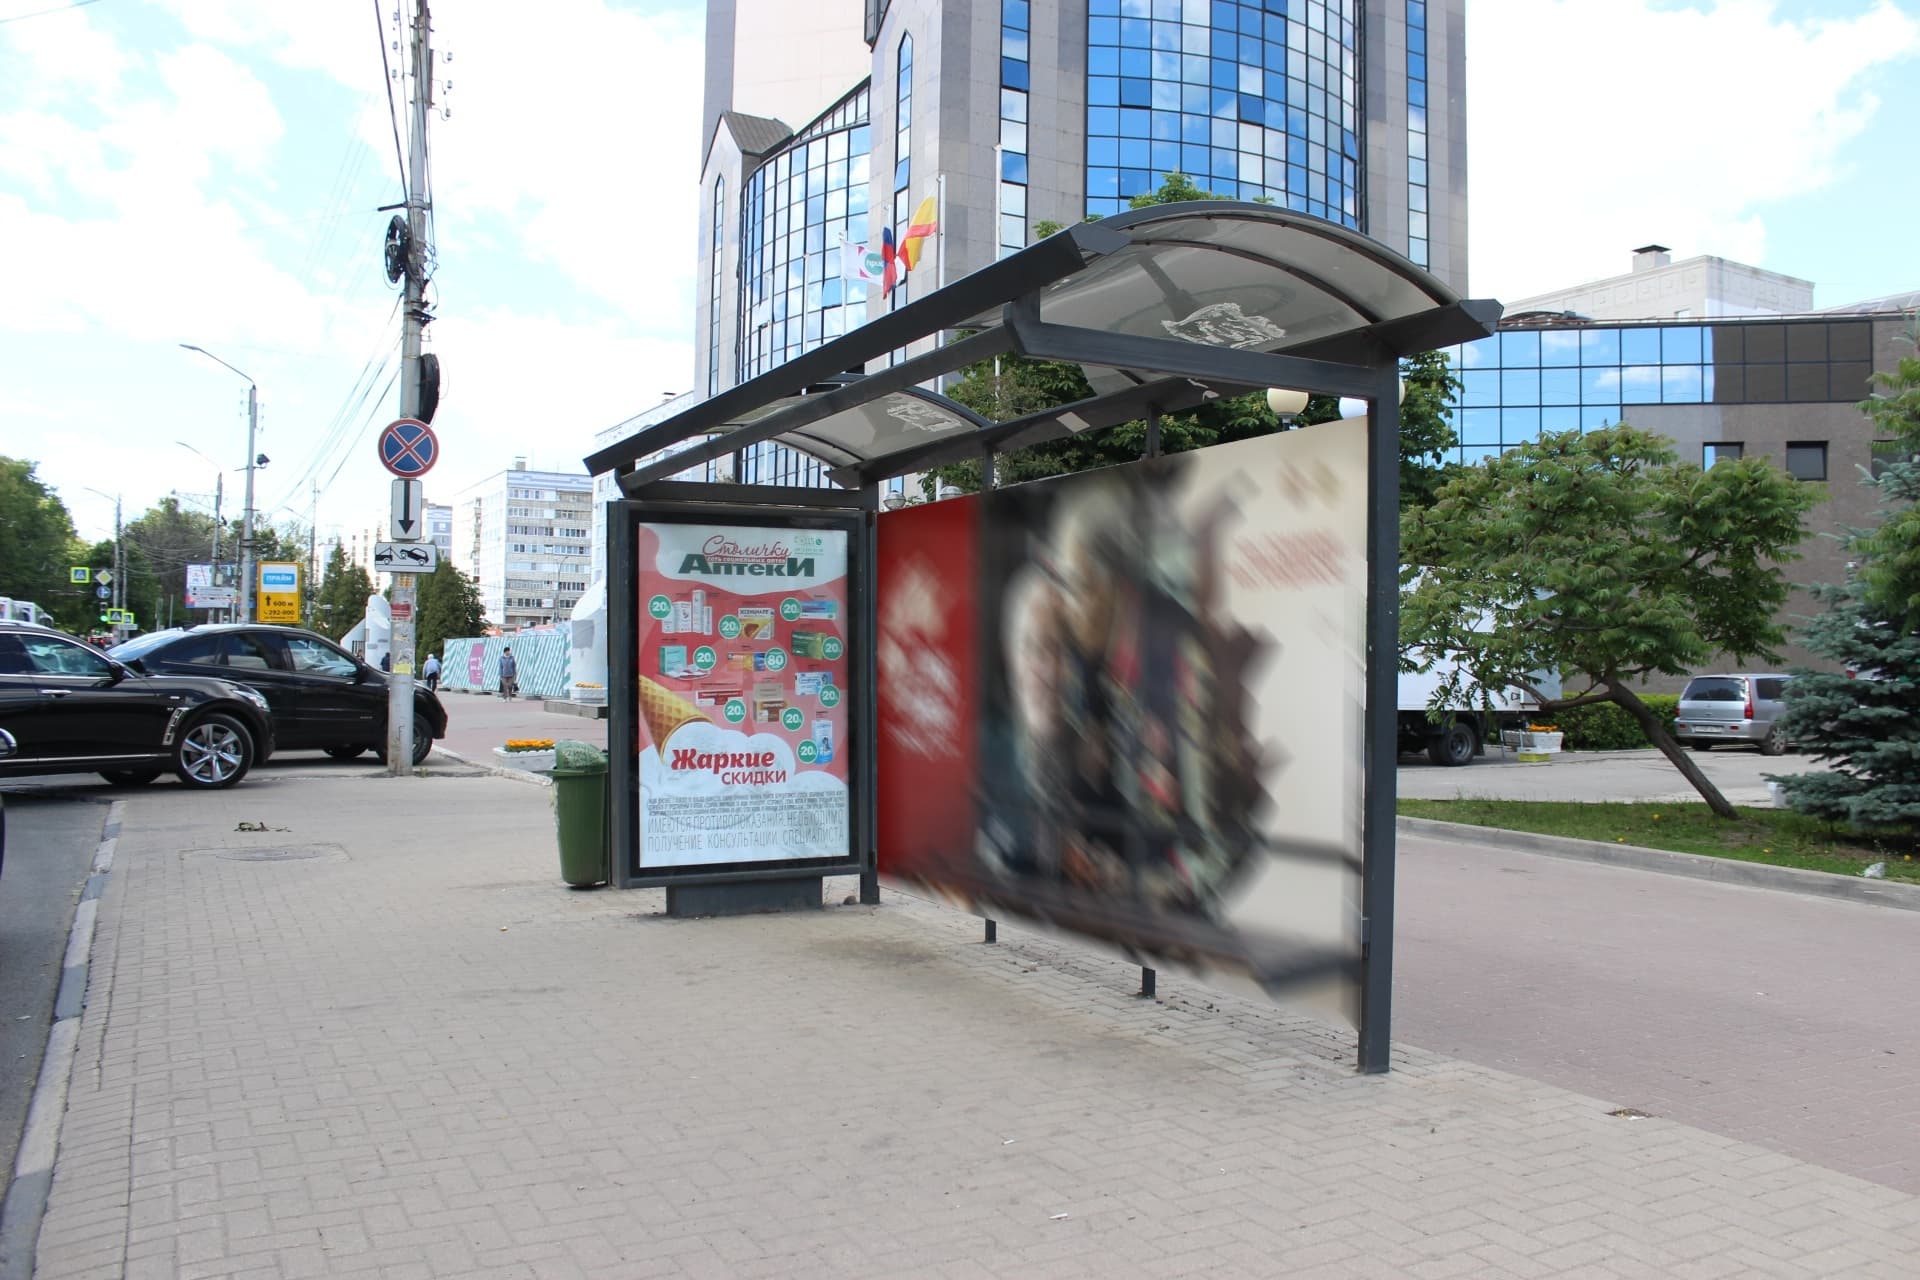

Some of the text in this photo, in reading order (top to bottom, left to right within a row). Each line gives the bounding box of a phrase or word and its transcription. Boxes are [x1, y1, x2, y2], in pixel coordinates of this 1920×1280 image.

[703, 535, 791, 556] Столички
[671, 748, 775, 775] Жаркие
[647, 815, 691, 834] ИМЕЮТСЯ
[647, 826, 844, 853] ПОЛУЧЕНИЕ КОНСУЛЬТАЦИИ СПЕЦИАЛИСТА
